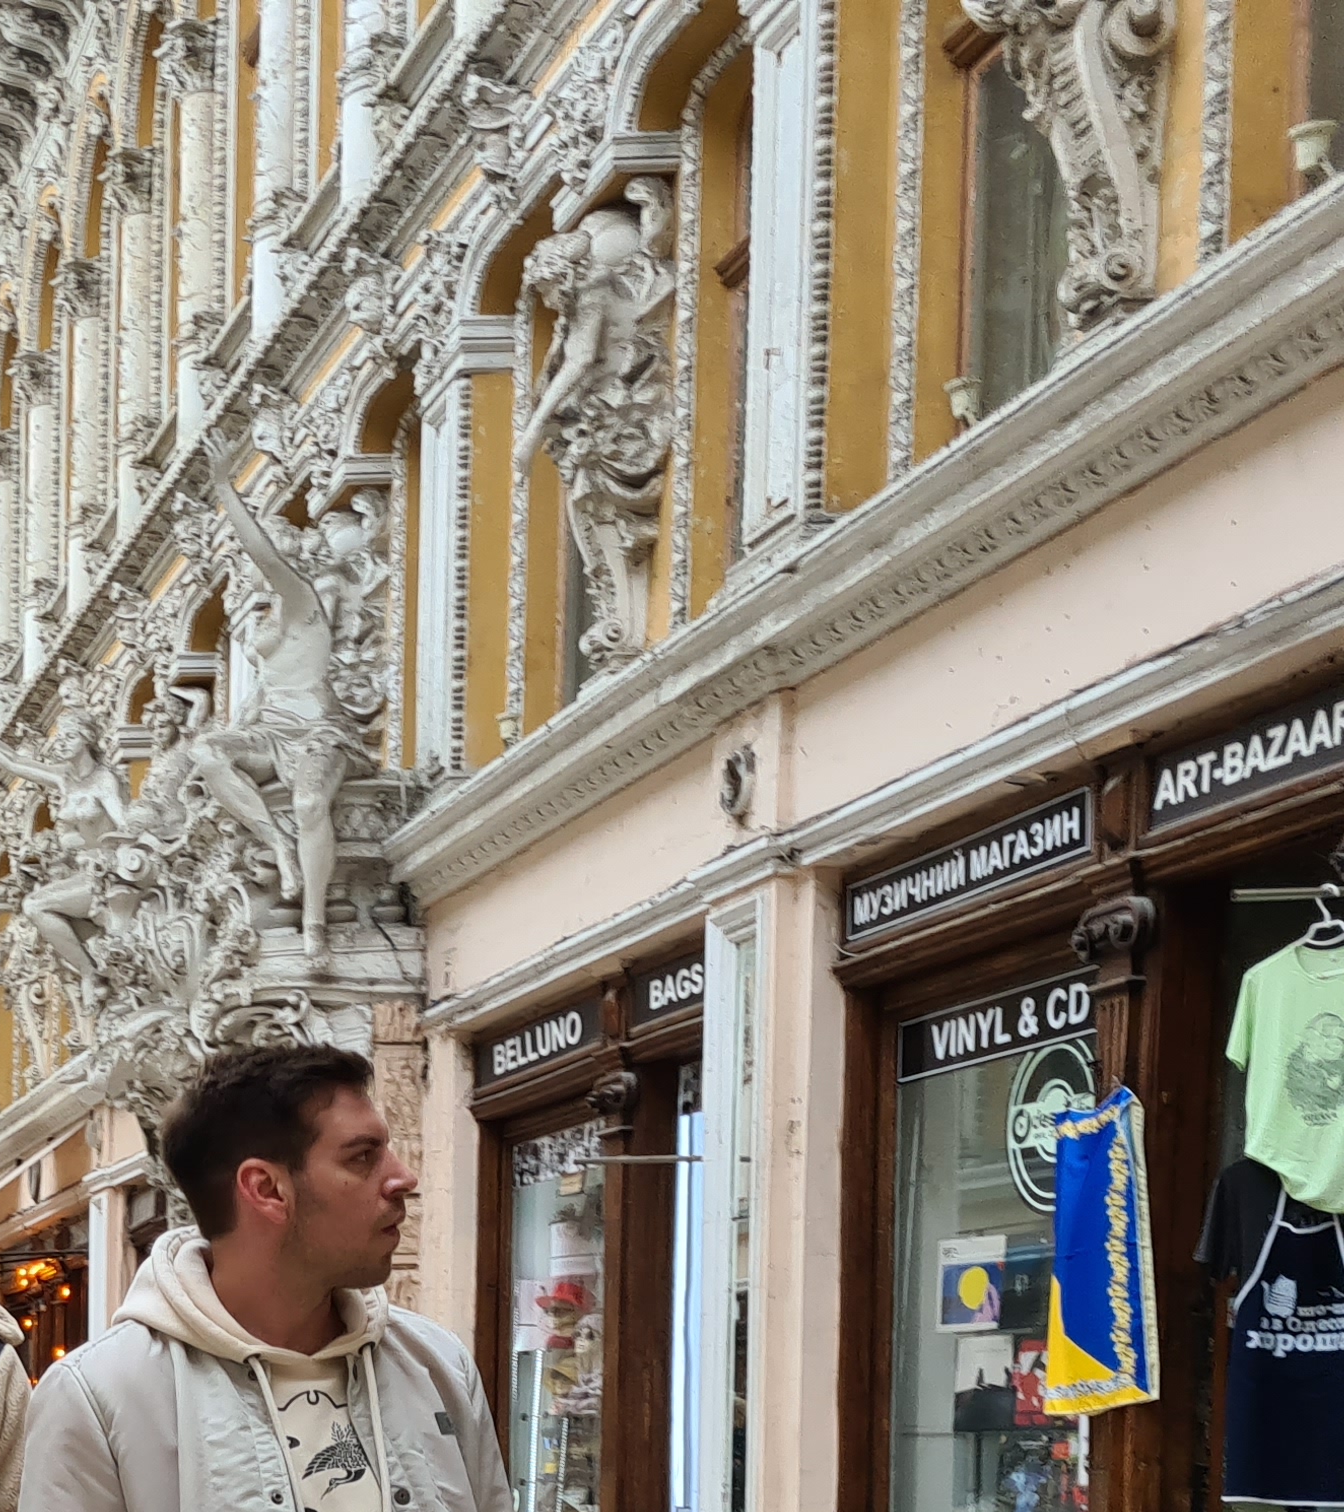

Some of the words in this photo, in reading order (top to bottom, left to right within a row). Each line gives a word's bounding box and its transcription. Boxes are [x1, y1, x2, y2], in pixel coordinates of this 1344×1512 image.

[853, 848, 966, 926] МУЗИЧНИЙ
[969, 806, 1080, 881] МАГАЗИН
[649, 962, 703, 1011] BAGS
[492, 1011, 583, 1076] BELLUNO
[931, 1006, 1012, 1060] VINYL
[1018, 996, 1039, 1038] &
[1046, 982, 1091, 1030] CD
[1245, 1330, 1344, 1358] хорош
